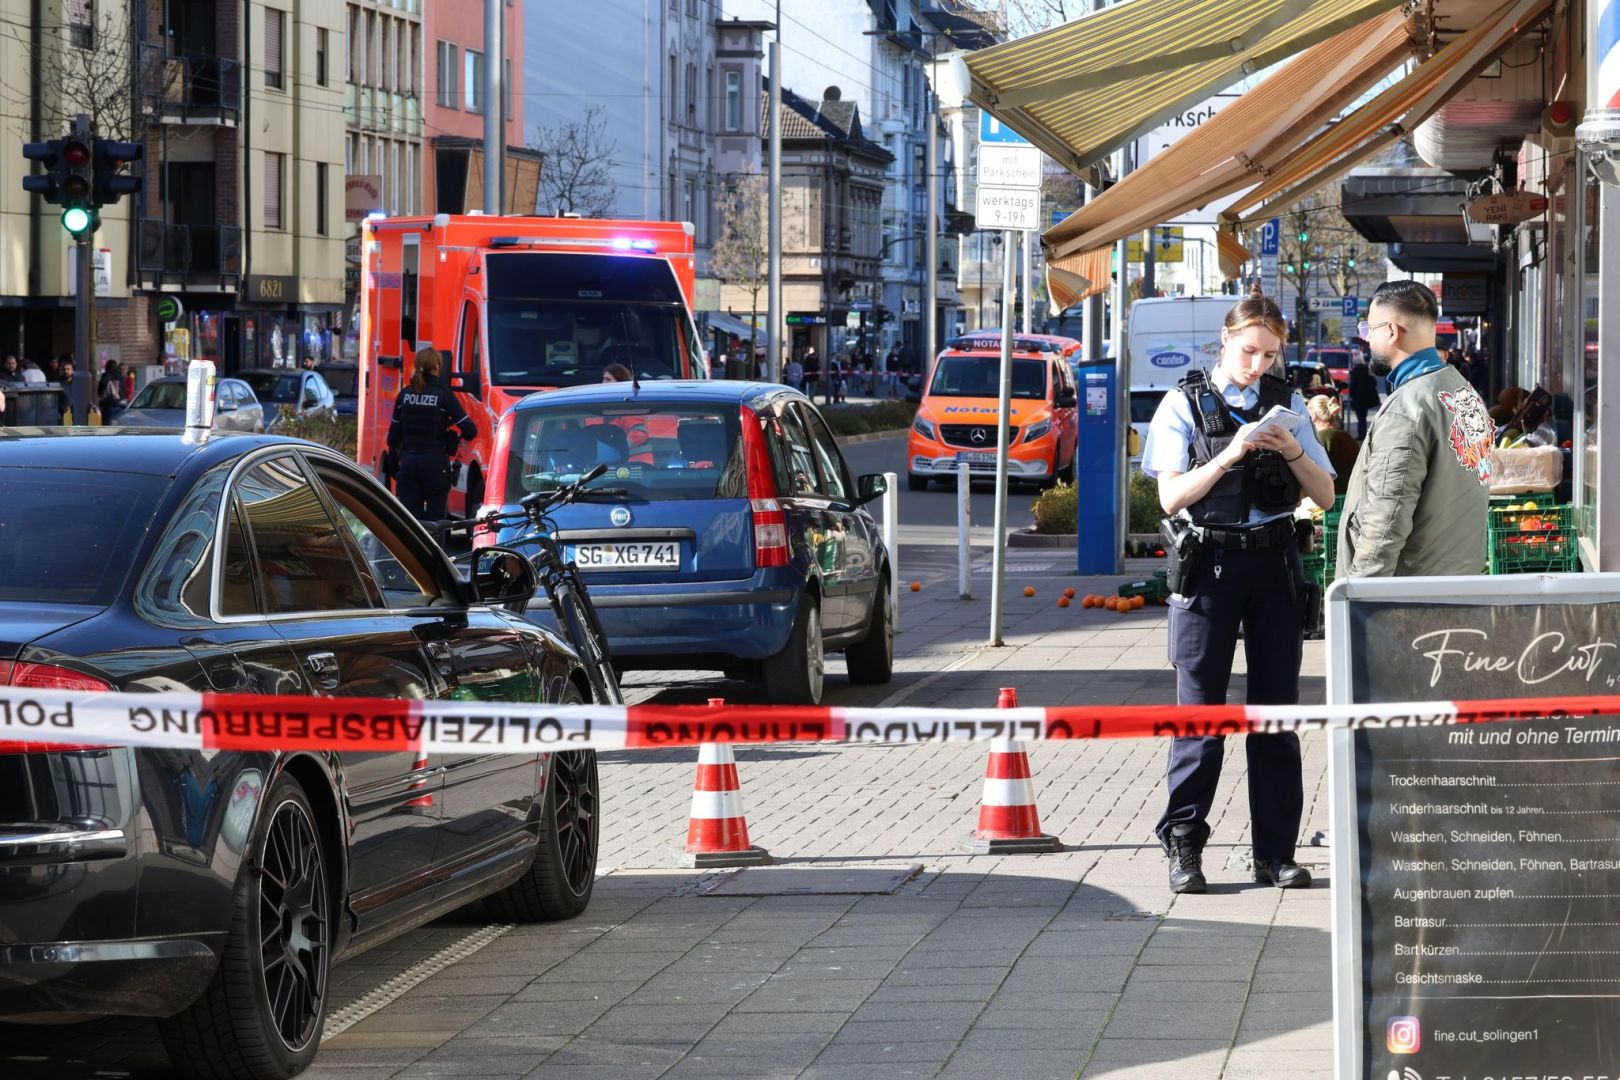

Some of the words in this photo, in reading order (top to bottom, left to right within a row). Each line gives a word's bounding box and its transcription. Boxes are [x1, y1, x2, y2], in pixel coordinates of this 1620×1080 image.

[983, 167, 1037, 178] Parkschein
[982, 196, 1035, 210] werktags
[260, 279, 283, 297] 6821
[973, 339, 1019, 349] NOTAT
[403, 393, 438, 407] POLIZEI
[943, 406, 1018, 415] Notart
[579, 547, 602, 564] SG
[615, 546, 638, 563] XG
[642, 545, 676, 563] 741
[1412, 629, 1515, 688] Fine
[1517, 631, 1617, 684] Cut
[1449, 729, 1474, 744] mit
[1479, 728, 1512, 744] und
[1516, 728, 1559, 744] ohne
[1389, 774, 1497, 787] Trockenhaarschnitt
[1490, 806, 1503, 814] bis
[1505, 806, 1515, 814] 12
[1391, 831, 1447, 844] Waschen,
[1450, 830, 1515, 843] Schneiden,
[1518, 830, 1562, 842] Föhnen
[1392, 859, 1448, 872] Waschen,
[1451, 858, 1516, 871] Schneiden,
[1520, 858, 1567, 871] Föhnen,
[1393, 887, 1471, 902] Augenbrauen
[1474, 886, 1514, 901] zupfen
[1394, 915, 1446, 927] Bartrasur
[1395, 971, 1483, 984] Gesichtsmaske
[1434, 1029, 1539, 1043] fine.cut_solingen1
